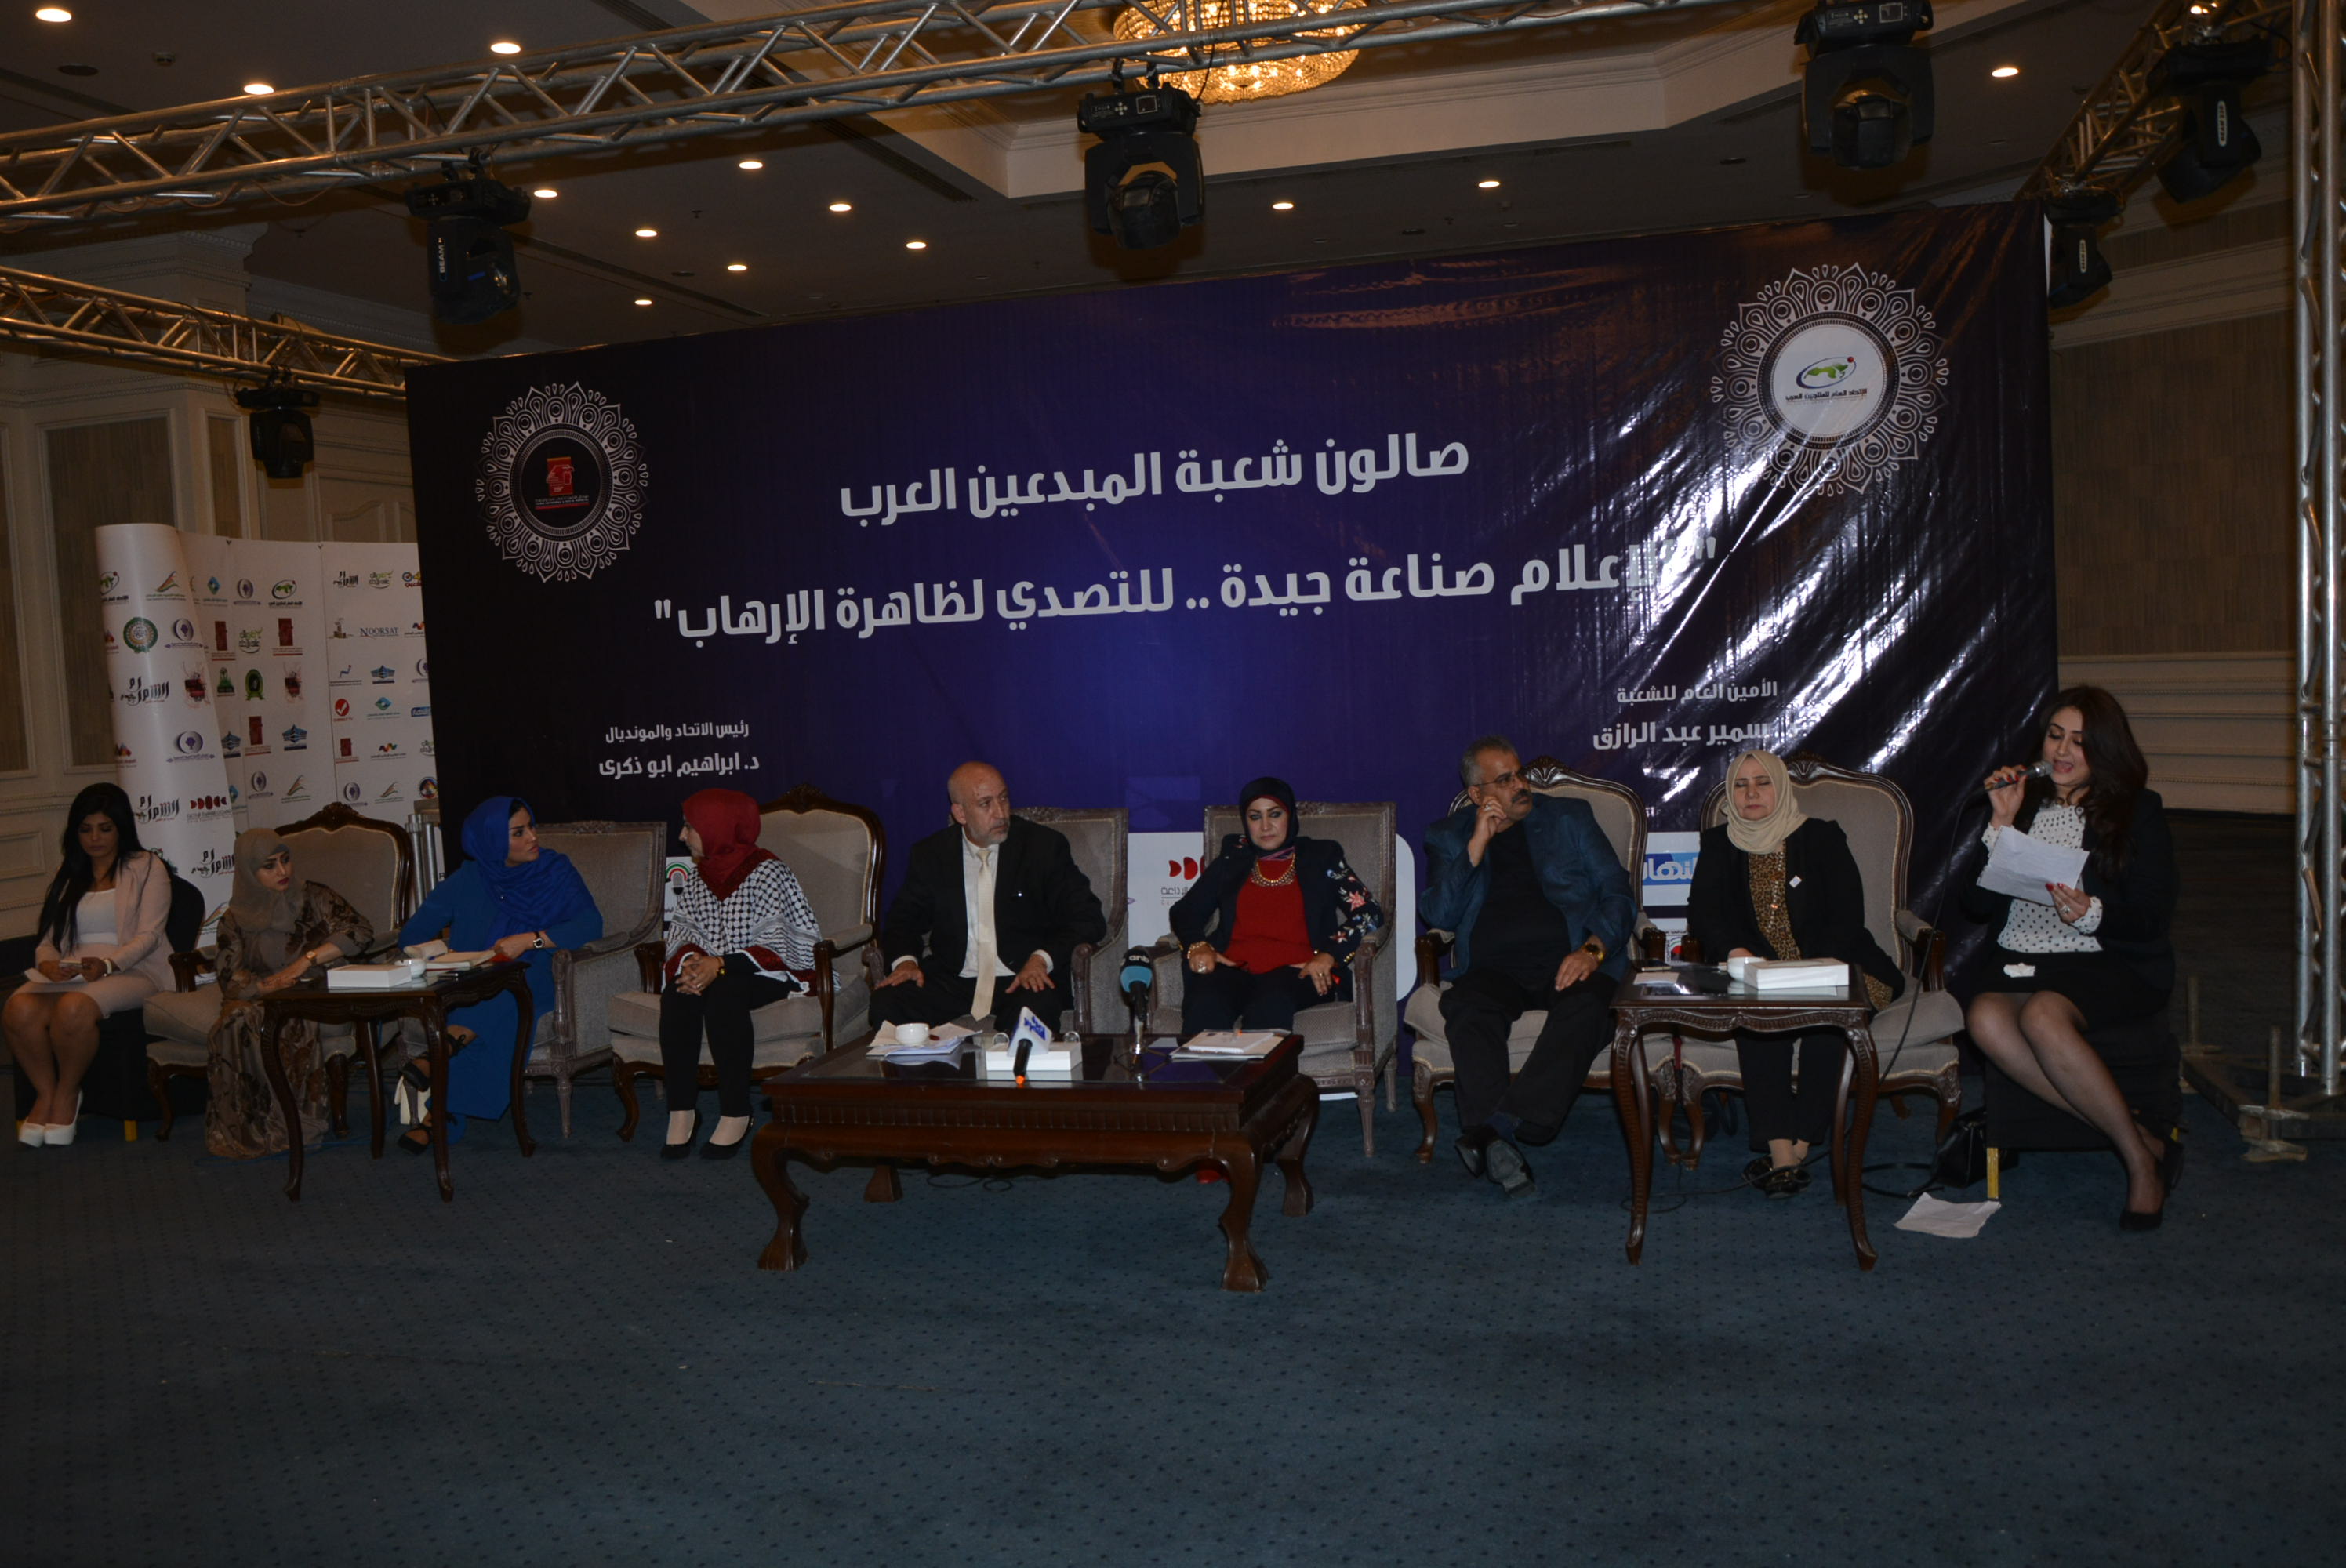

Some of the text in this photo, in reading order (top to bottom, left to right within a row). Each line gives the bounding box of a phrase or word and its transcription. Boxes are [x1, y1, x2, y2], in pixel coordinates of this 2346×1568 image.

[841, 432, 1469, 527] صالون شعبة المبدعين العرب
[1220, 564, 1331, 617] جيدة
[1346, 552, 1494, 601] صناعة
[836, 579, 984, 639] لظاهرة
[996, 568, 1174, 630] للتصدي
[360, 627, 399, 636] NOORSAT
[1616, 678, 1778, 706] الأمين العام للشعبة
[605, 720, 749, 743] رئيس الاتحاد والمونديال
[1593, 721, 1656, 750] الرازق
[1662, 724, 1701, 746] عبد
[599, 756, 643, 780] ذكرى
[647, 754, 673, 779] ابو
[677, 752, 740, 777] ابراهيم
